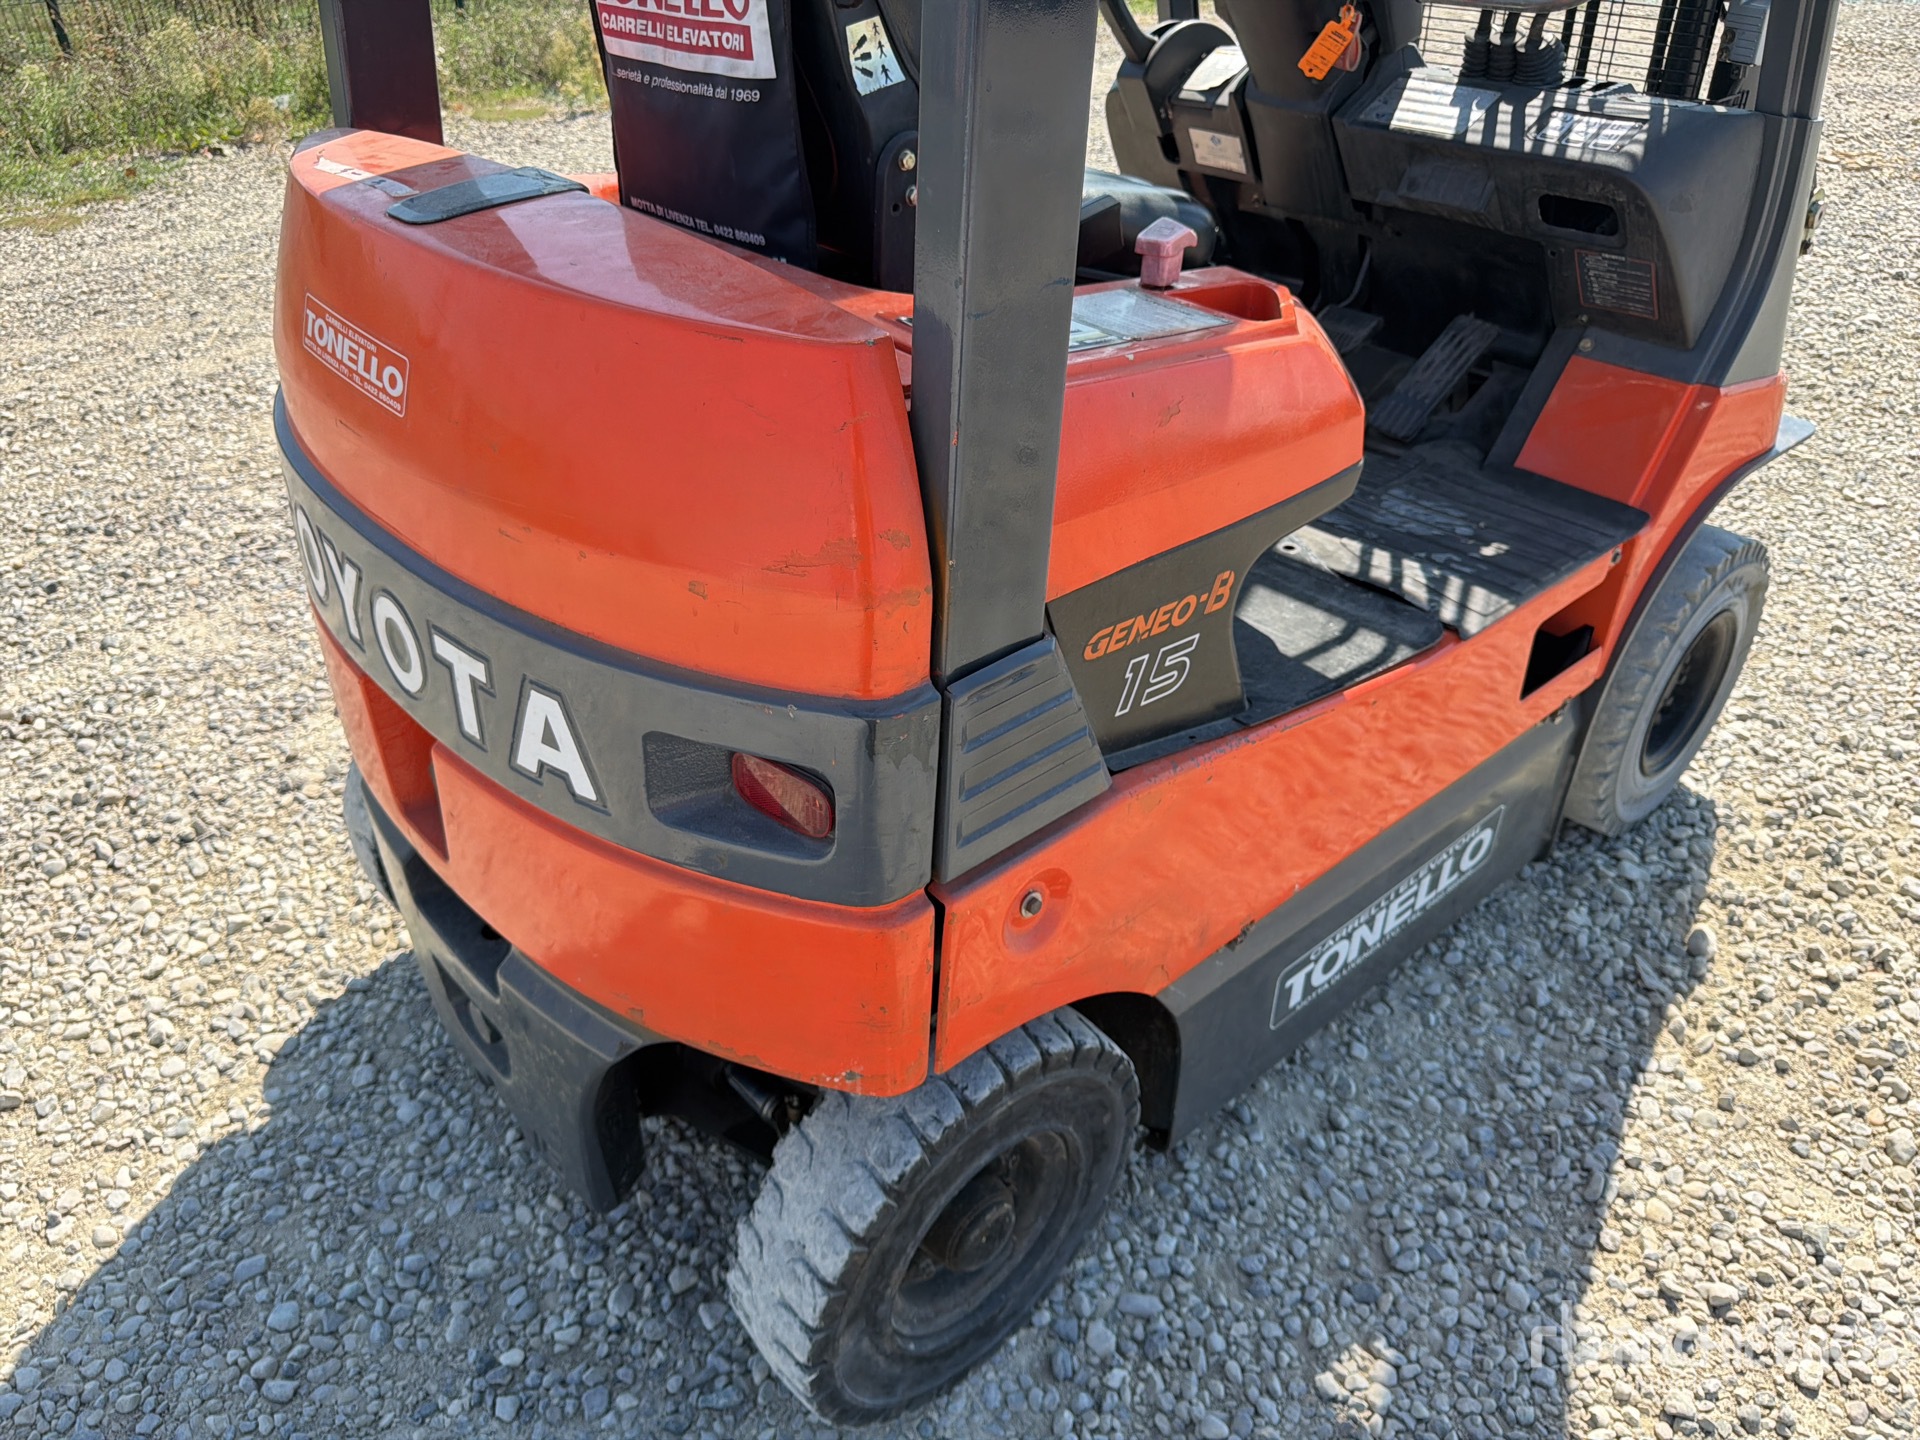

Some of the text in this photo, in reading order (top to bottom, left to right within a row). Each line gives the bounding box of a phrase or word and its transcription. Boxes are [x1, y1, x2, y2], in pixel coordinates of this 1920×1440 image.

[666, 25, 745, 52] ELEVATORI
[643, 74, 650, 85] e
[651, 76, 714, 98] professionalità
[715, 86, 728, 100] dal
[730, 88, 761, 103] 1969
[630, 196, 656, 214] MOTTA
[664, 208, 695, 229] LIVENZA
[306, 308, 404, 398] TONELLO
[295, 504, 598, 801] OYOTA
[1083, 570, 1235, 661] GENEO-B
[1114, 632, 1201, 718] 15
[1284, 827, 1494, 1010] TONELLO
